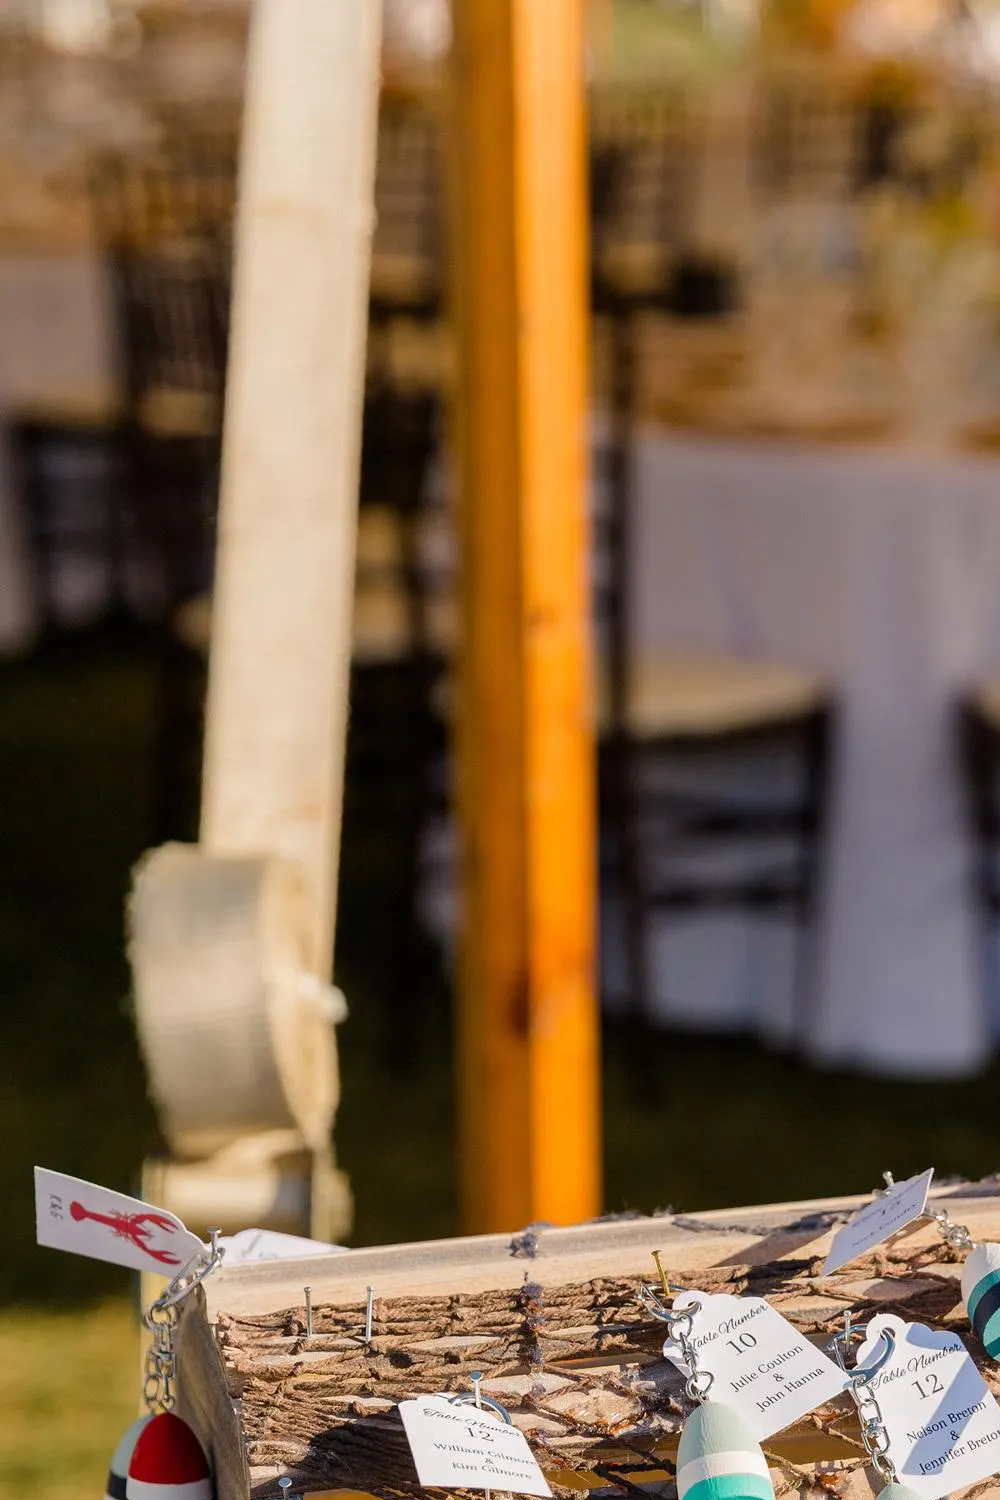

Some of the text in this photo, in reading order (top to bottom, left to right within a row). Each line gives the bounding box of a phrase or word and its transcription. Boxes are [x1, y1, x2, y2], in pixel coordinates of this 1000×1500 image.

[718, 1304, 769, 1335] Number
[725, 1332, 758, 1357] 10
[729, 1345, 804, 1394] Julie Coulton
[773, 1371, 785, 1384] &
[871, 1343, 963, 1391] Table Number
[755, 1368, 826, 1414] John Hanna
[911, 1373, 945, 1401] 12
[423, 1407, 522, 1438] Table Number
[465, 1427, 495, 1443] 12
[906, 1400, 987, 1444] Nelson Breton
[949, 1430, 960, 1442] &
[433, 1442, 538, 1466] William Gilmore
[485, 1457, 494, 1465] &
[918, 1445, 967, 1476] Jennifer
[452, 1461, 534, 1480] Kim Gilmore
